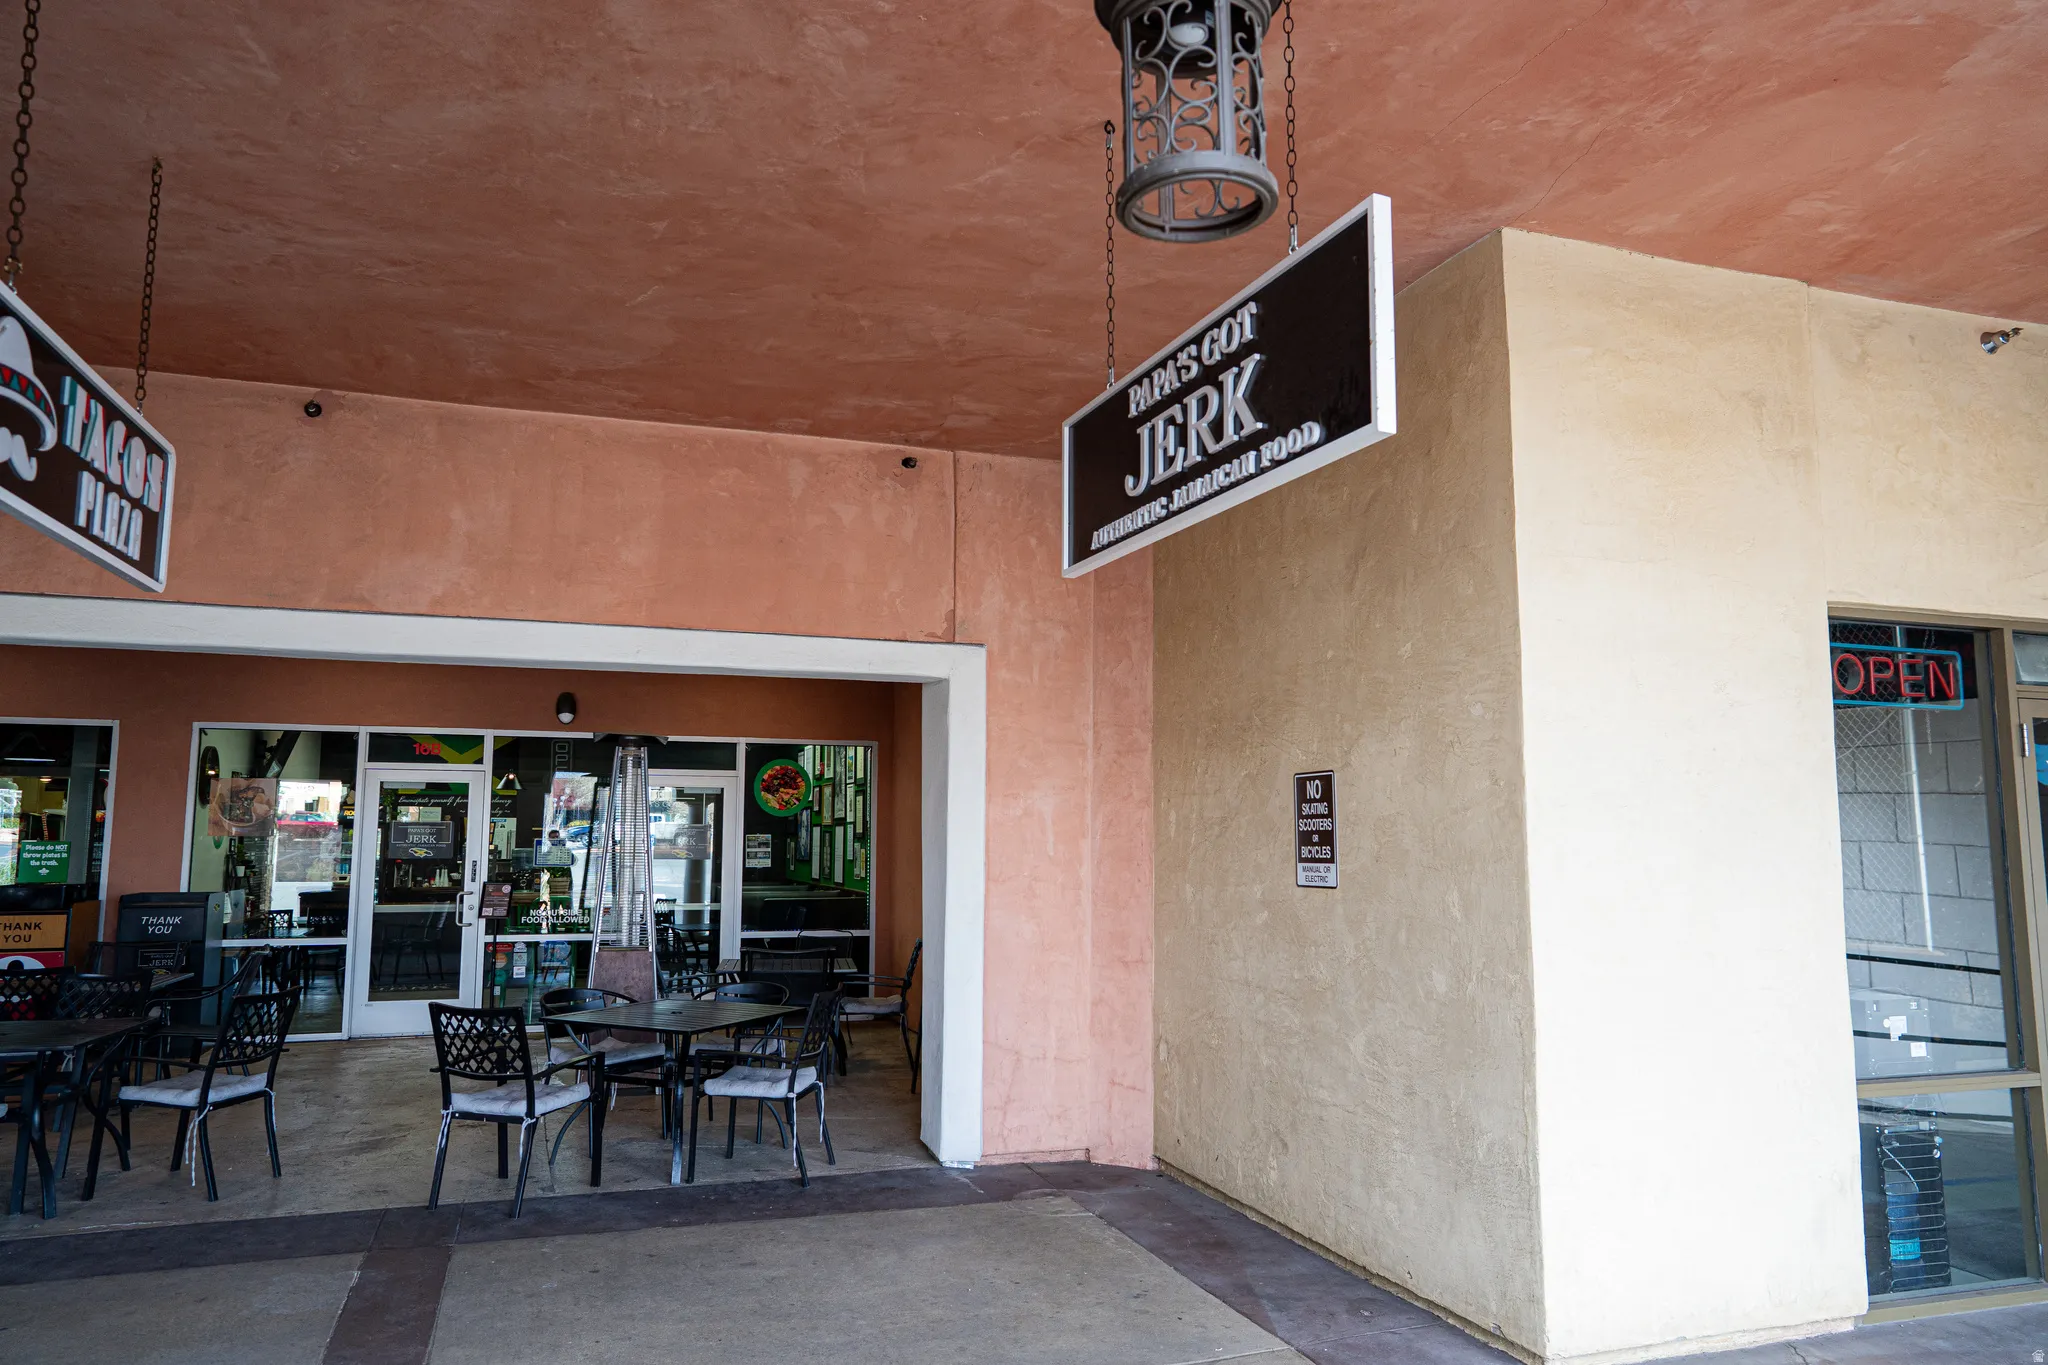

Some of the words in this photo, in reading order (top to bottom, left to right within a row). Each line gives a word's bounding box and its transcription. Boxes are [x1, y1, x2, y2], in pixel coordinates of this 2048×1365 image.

[1128, 344, 1199, 418] PAPA'S
[1201, 301, 1258, 366] GOT
[1124, 353, 1265, 497] JERK
[60, 376, 164, 512] TACOS
[1090, 497, 1168, 550] AUTHENTIC
[1169, 450, 1257, 512] JAMAICAN
[1259, 421, 1321, 469] FOOD
[75, 470, 143, 562] PLAZA
[1833, 653, 1955, 699] OPEN
[413, 742, 442, 755] 16B
[1306, 779, 1322, 800] NO
[1301, 802, 1328, 815] SKATING
[1298, 818, 1332, 831] SCOOTERS
[405, 835, 437, 844] JERK
[1312, 834, 1319, 842] OR
[1301, 846, 1331, 858] BICYCLES
[1302, 865, 1322, 874] MANUAL
[1322, 865, 1331, 874] OR
[1305, 875, 1328, 884] ELECTRIC
[141, 916, 182, 924] THANK
[148, 926, 173, 934] YOU
[4, 934, 32, 943] YOU
[149, 959, 174, 967] JERK
